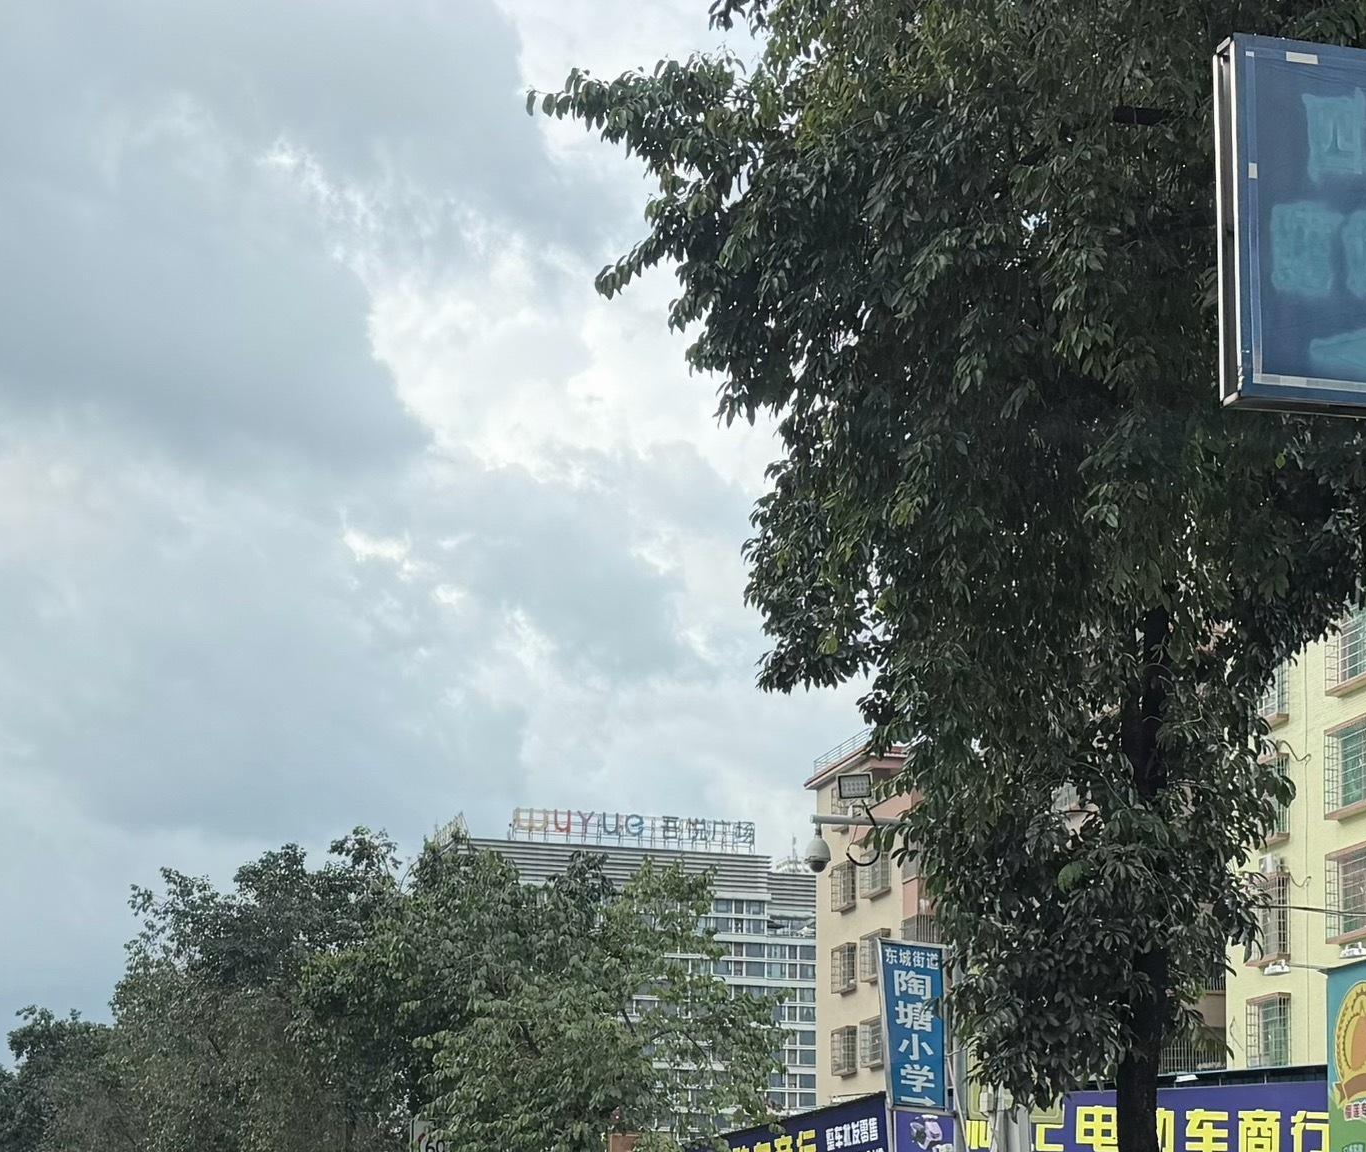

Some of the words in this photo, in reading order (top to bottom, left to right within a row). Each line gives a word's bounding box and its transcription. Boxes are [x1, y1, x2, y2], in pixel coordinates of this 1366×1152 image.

[885, 947, 939, 970] 东城街道
[893, 969, 936, 1093] 陶塘小学
